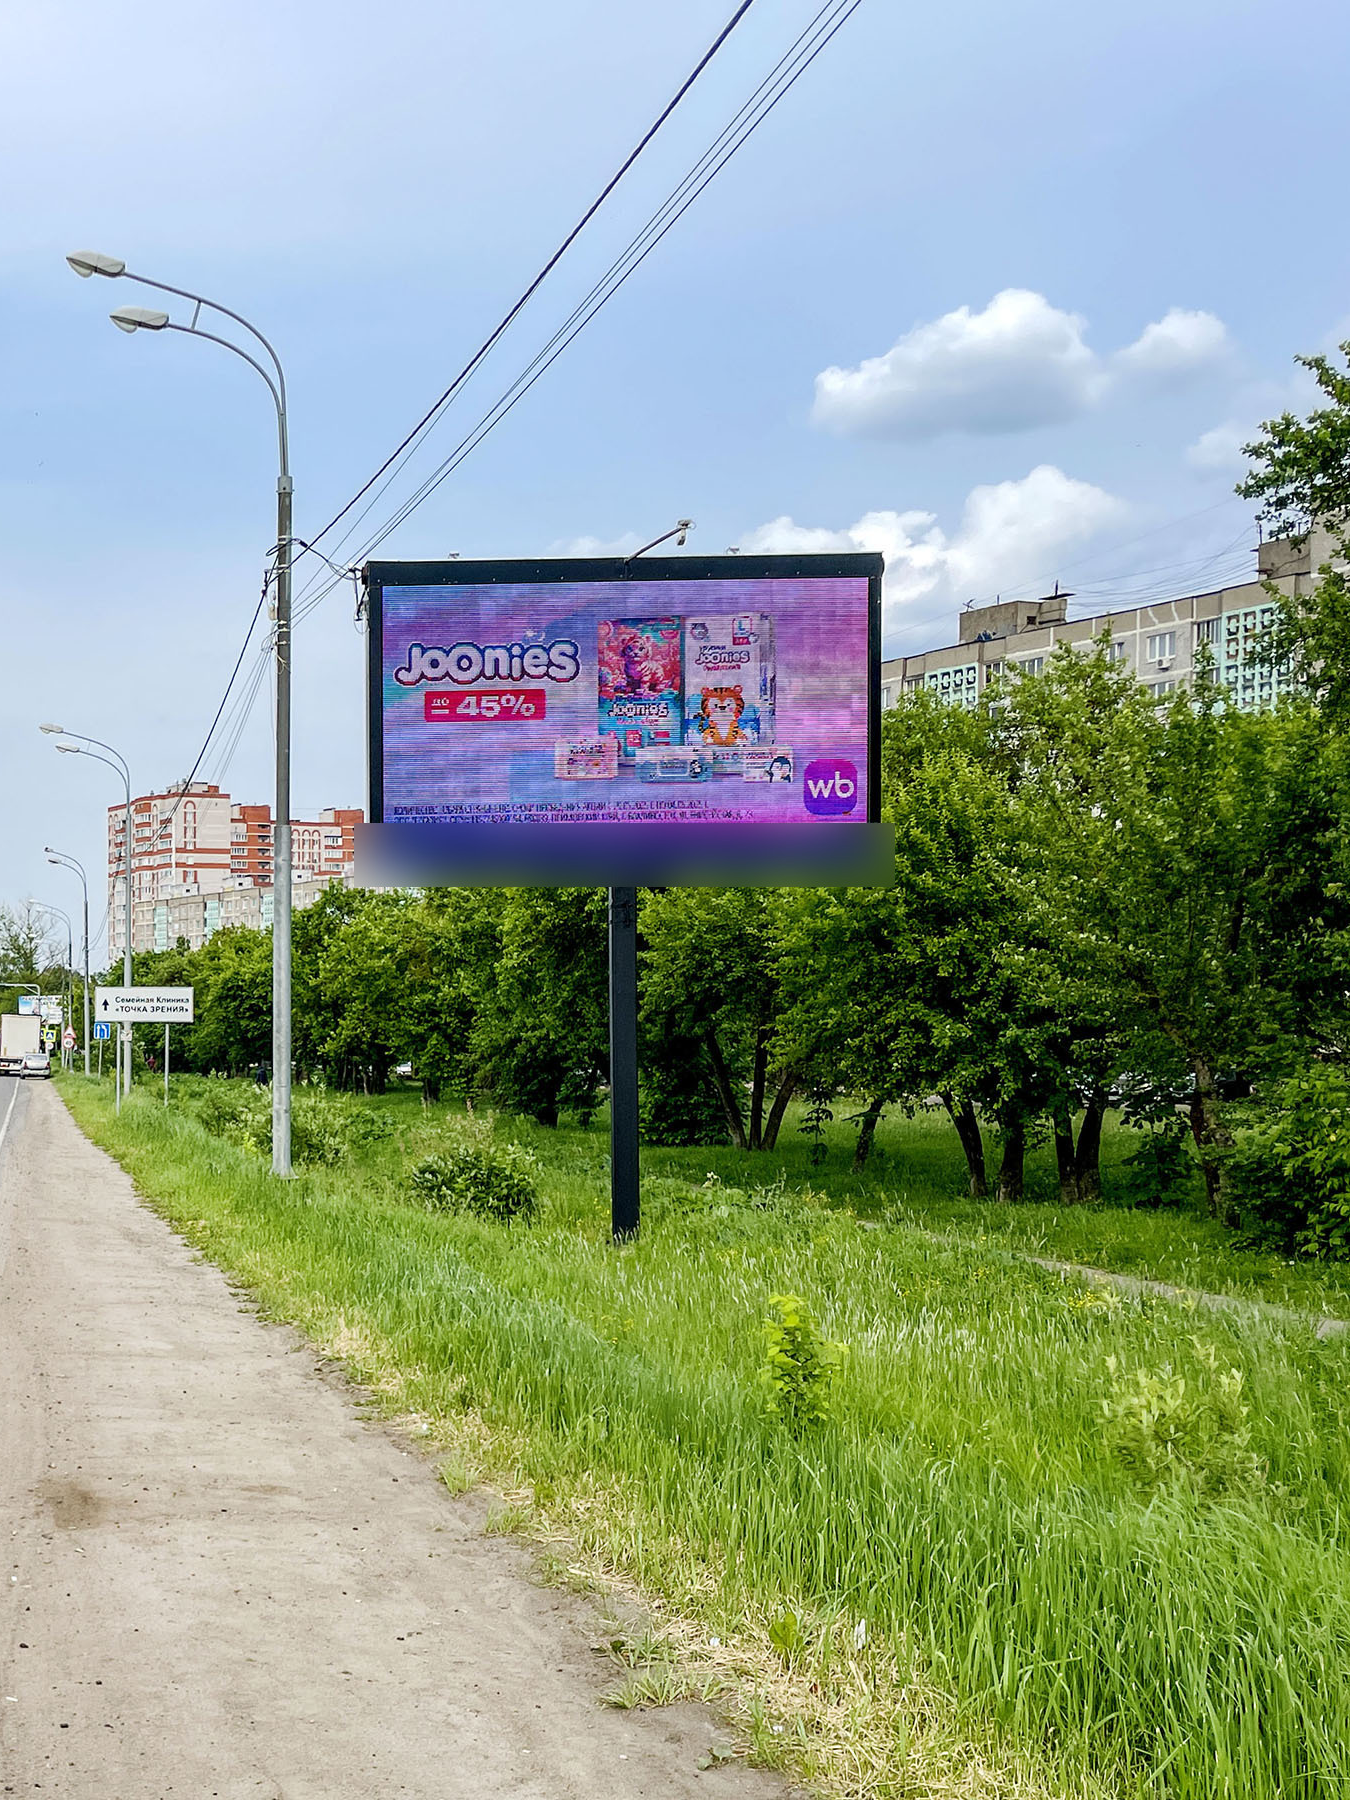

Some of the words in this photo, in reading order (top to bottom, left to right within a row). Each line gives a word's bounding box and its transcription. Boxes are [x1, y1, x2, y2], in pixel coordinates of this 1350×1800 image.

[807, 771, 855, 799] wb
[114, 996, 155, 1004] Семейная
[156, 996, 190, 1004] Клиника
[115, 1005, 148, 1013] «ТОЧКА
[150, 1005, 189, 1013] ЗРЕНИЯ»
